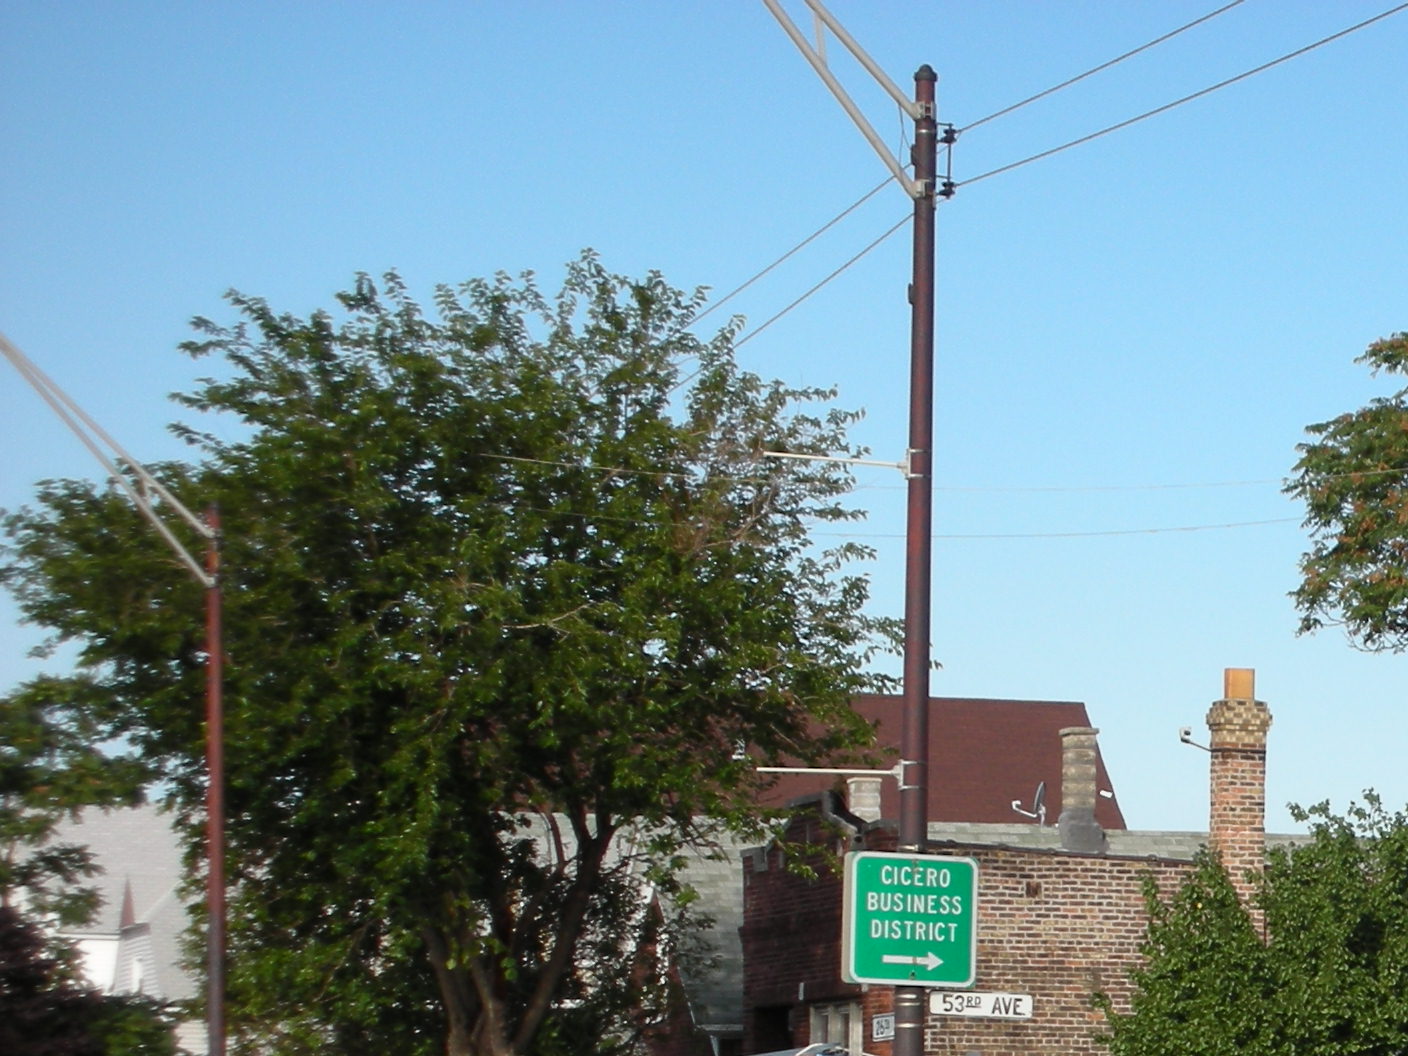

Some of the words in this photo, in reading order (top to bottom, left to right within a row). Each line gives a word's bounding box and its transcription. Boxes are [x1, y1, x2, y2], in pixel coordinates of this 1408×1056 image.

[881, 865, 951, 888] CICERO
[867, 892, 962, 915] BUSINESS
[871, 919, 958, 942] DISTRICT
[942, 994, 982, 1013] 53RD
